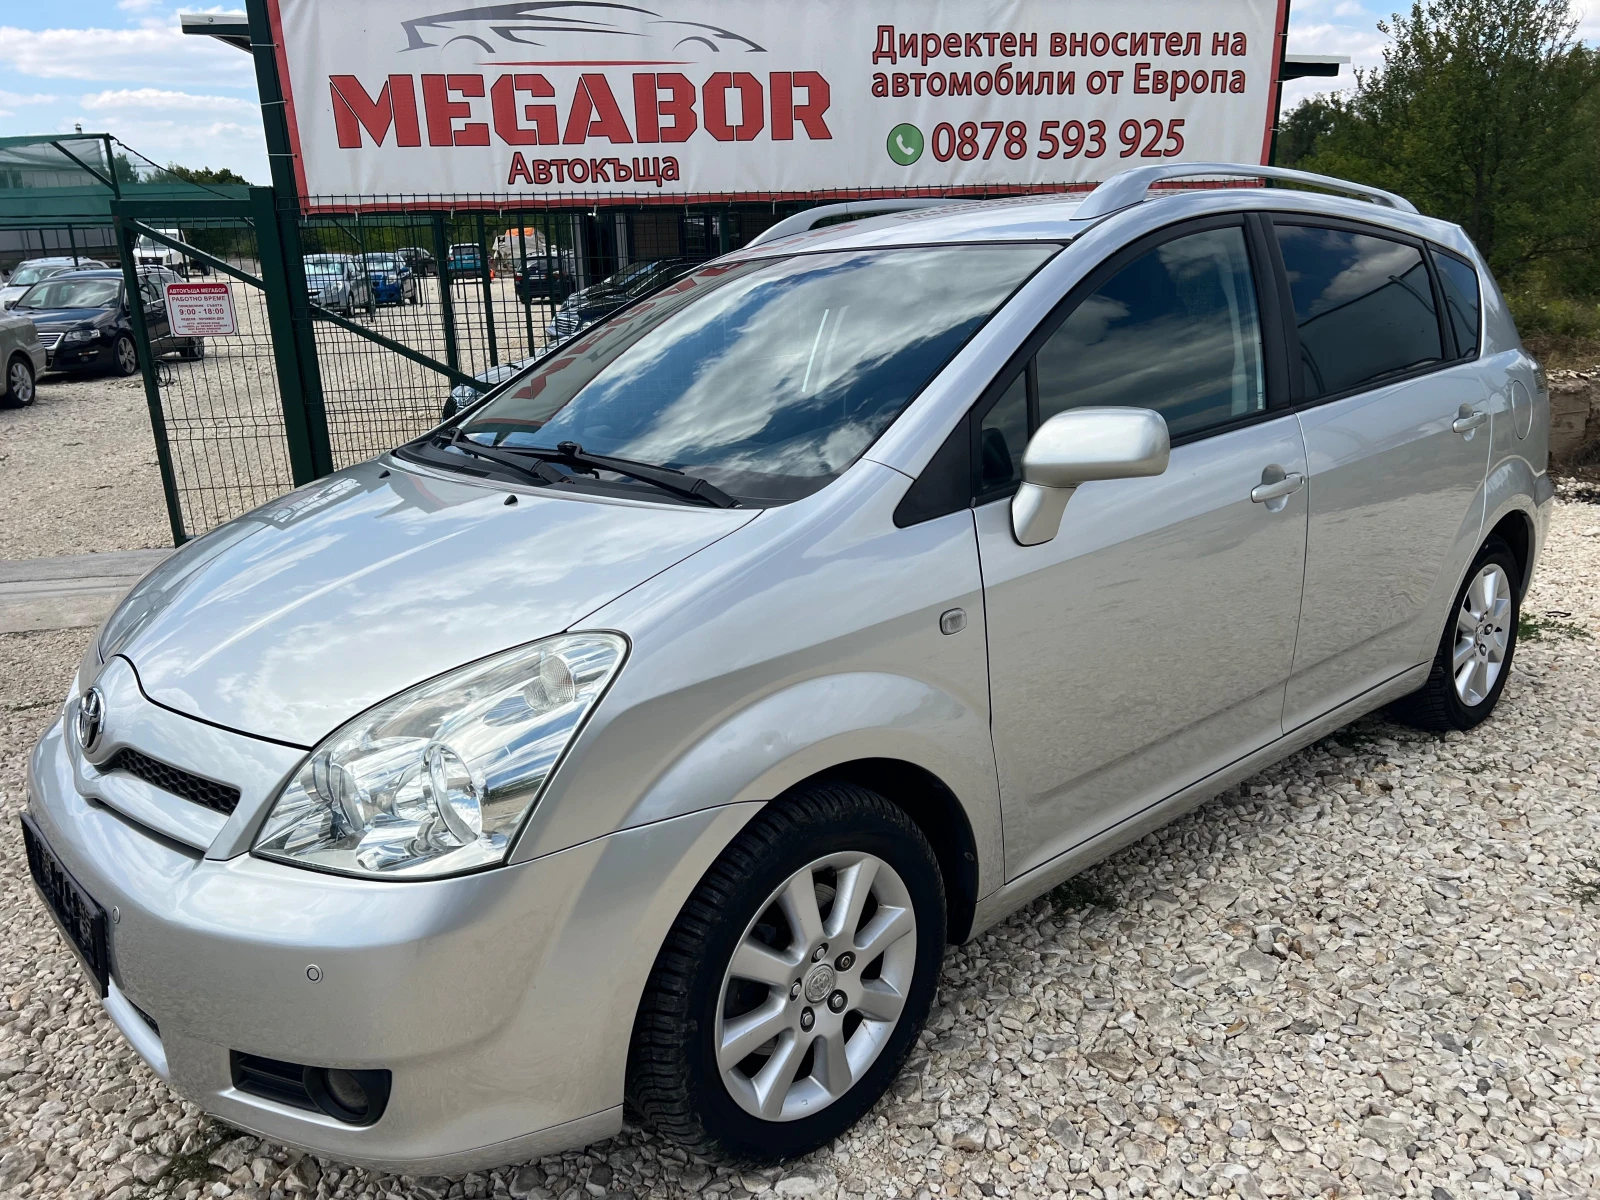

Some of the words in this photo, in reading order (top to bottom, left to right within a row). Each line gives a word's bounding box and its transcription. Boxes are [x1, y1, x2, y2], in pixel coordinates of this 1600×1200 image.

[872, 24, 1038, 66] Директен
[1049, 31, 1201, 57] вносител
[1211, 31, 1248, 57] на
[871, 62, 1076, 98] автомобили
[1086, 70, 1124, 95] от
[1133, 63, 1247, 101] Европа
[329, 70, 833, 149] MEGABOR
[931, 119, 1028, 162] 0878
[1037, 119, 1107, 160] 593
[1119, 118, 1185, 158] 925
[507, 151, 680, 188] Автокъща
